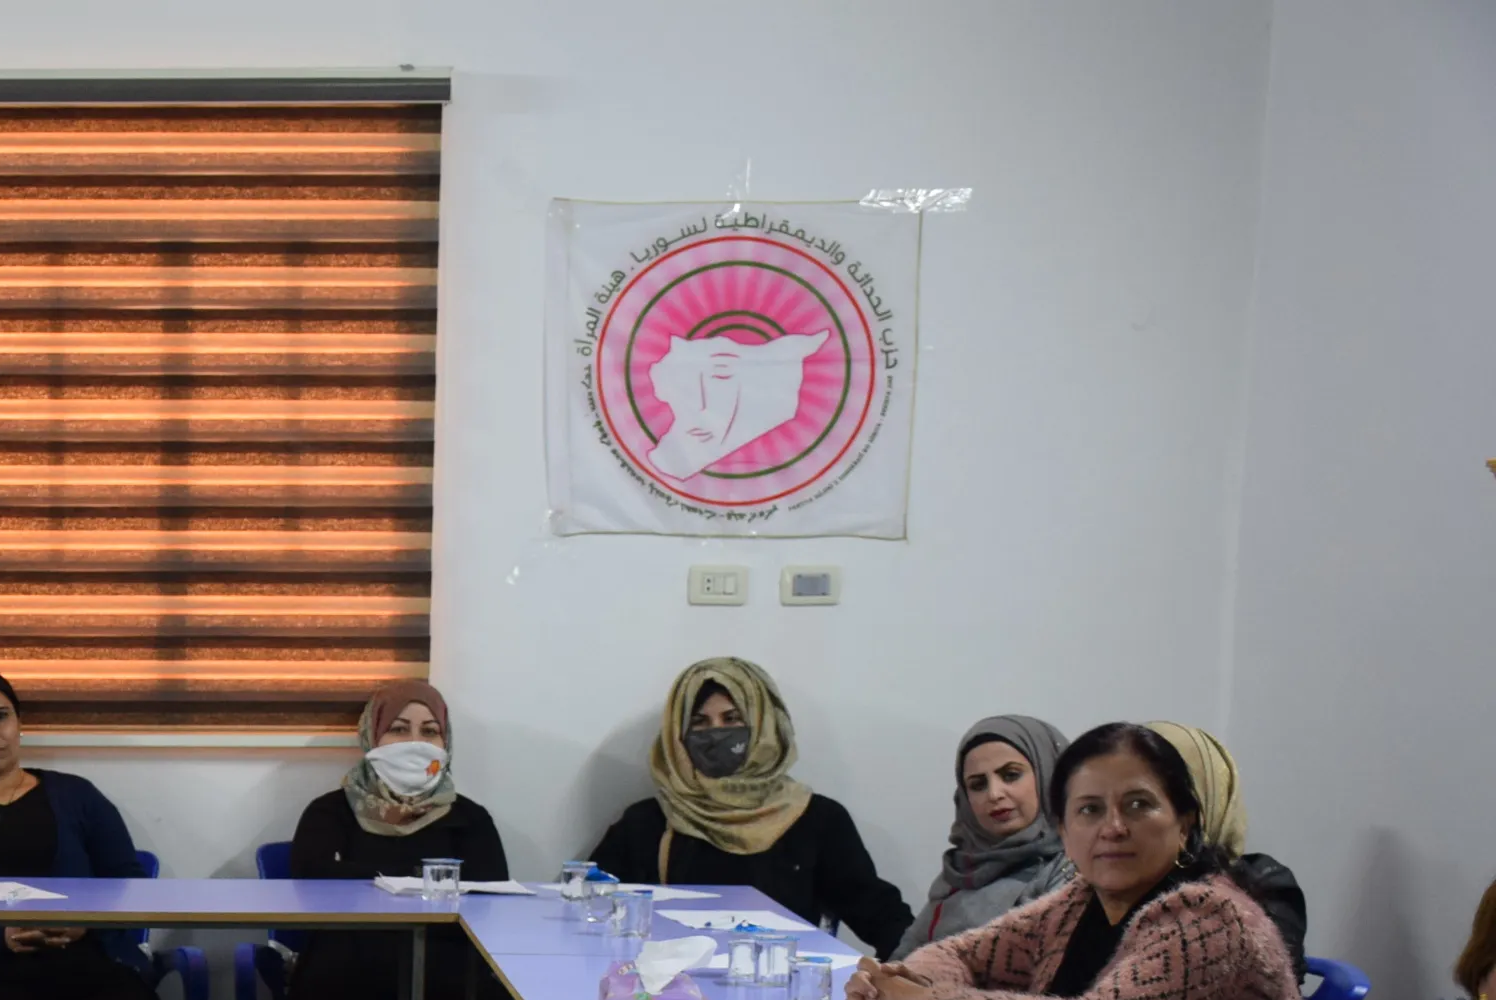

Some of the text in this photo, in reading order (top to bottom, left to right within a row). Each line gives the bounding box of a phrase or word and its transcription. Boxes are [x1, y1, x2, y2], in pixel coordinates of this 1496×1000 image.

[714, 212, 846, 266] والديمقراطية
[594, 270, 626, 304] هيئة
[847, 261, 893, 322] الحداثة
[574, 307, 602, 357] المرأة
[879, 328, 899, 370] حزب
